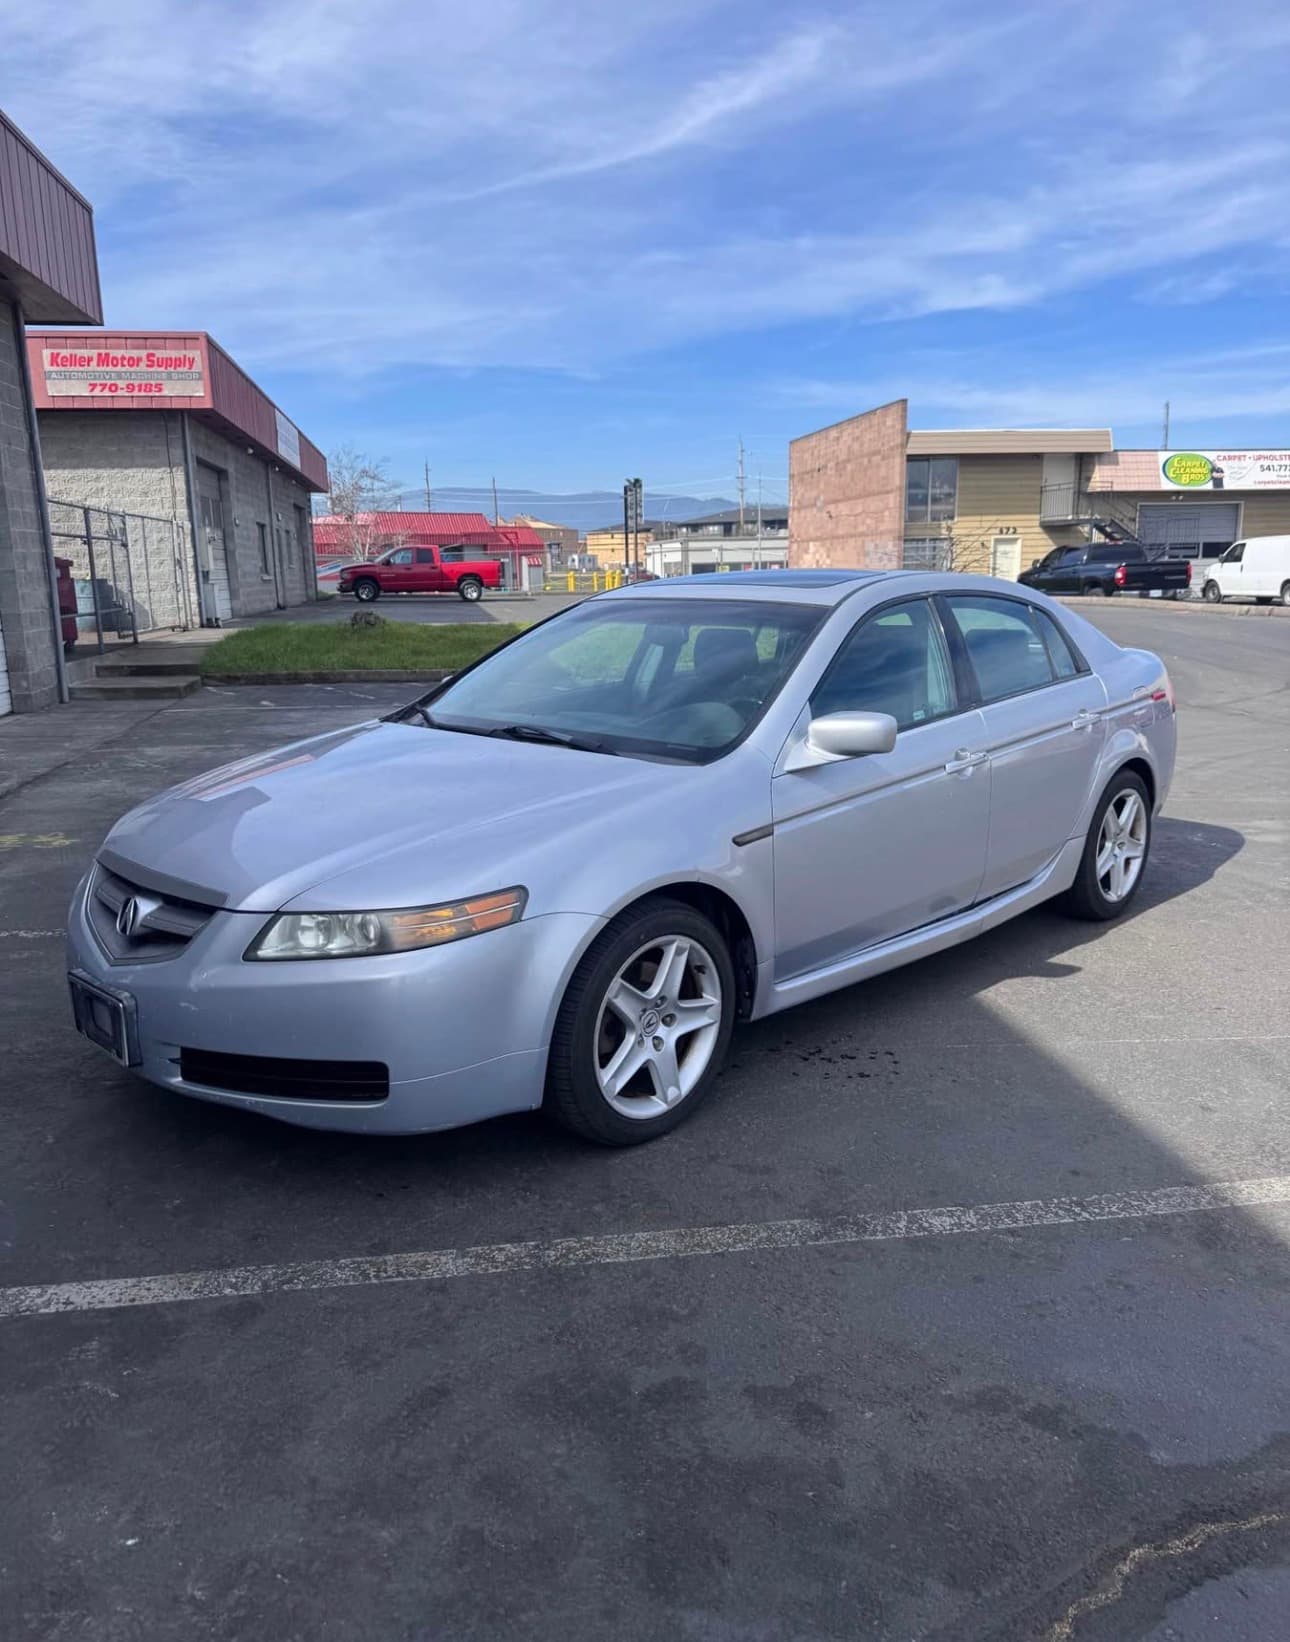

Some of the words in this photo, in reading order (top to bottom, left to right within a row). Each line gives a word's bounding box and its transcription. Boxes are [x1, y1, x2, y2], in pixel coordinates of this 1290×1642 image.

[50, 352, 93, 367] Keller
[96, 352, 142, 368] Motor
[145, 352, 195, 370] Supply
[121, 372, 168, 380] MACHINE
[88, 382, 163, 393] 770-9185
